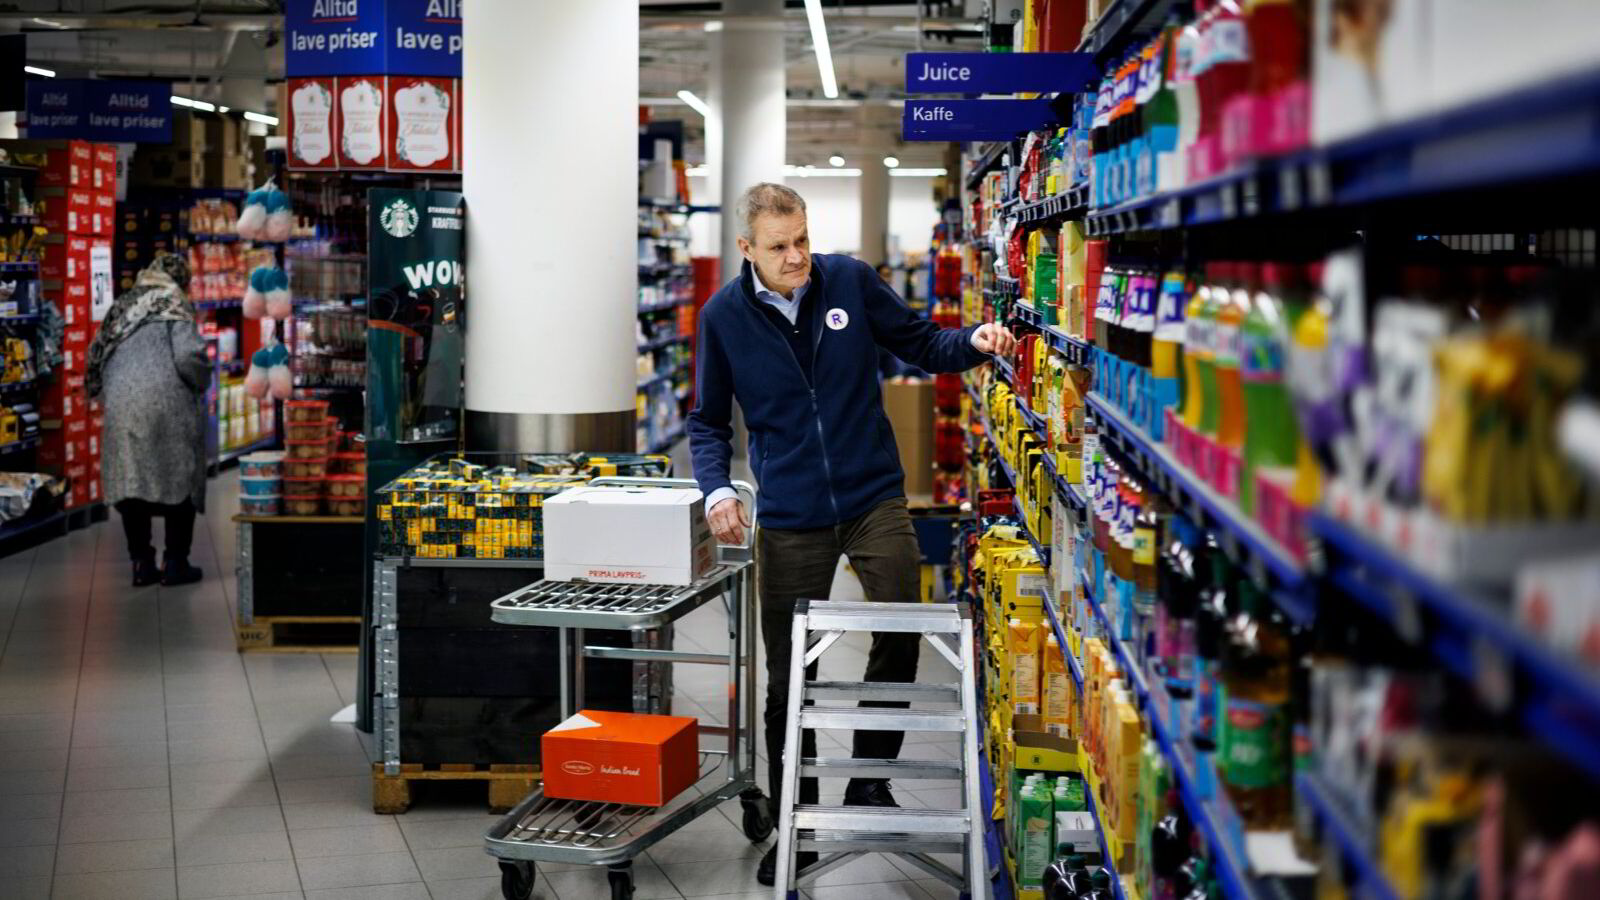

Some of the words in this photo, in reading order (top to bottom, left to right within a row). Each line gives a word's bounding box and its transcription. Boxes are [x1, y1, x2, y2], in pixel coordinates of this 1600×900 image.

[312, 0, 357, 17] Alltid
[292, 30, 325, 50] lave
[329, 27, 378, 53] priser
[397, 27, 443, 50] lave
[918, 62, 971, 81] Juice
[41, 93, 68, 106] Alltid
[108, 93, 149, 108] Alltid
[30, 113, 49, 126] lave
[51, 114, 78, 127] priser
[89, 112, 119, 127] lave
[122, 115, 165, 128] priser
[913, 106, 954, 121] Kaffe
[832, 313, 842, 325] R
